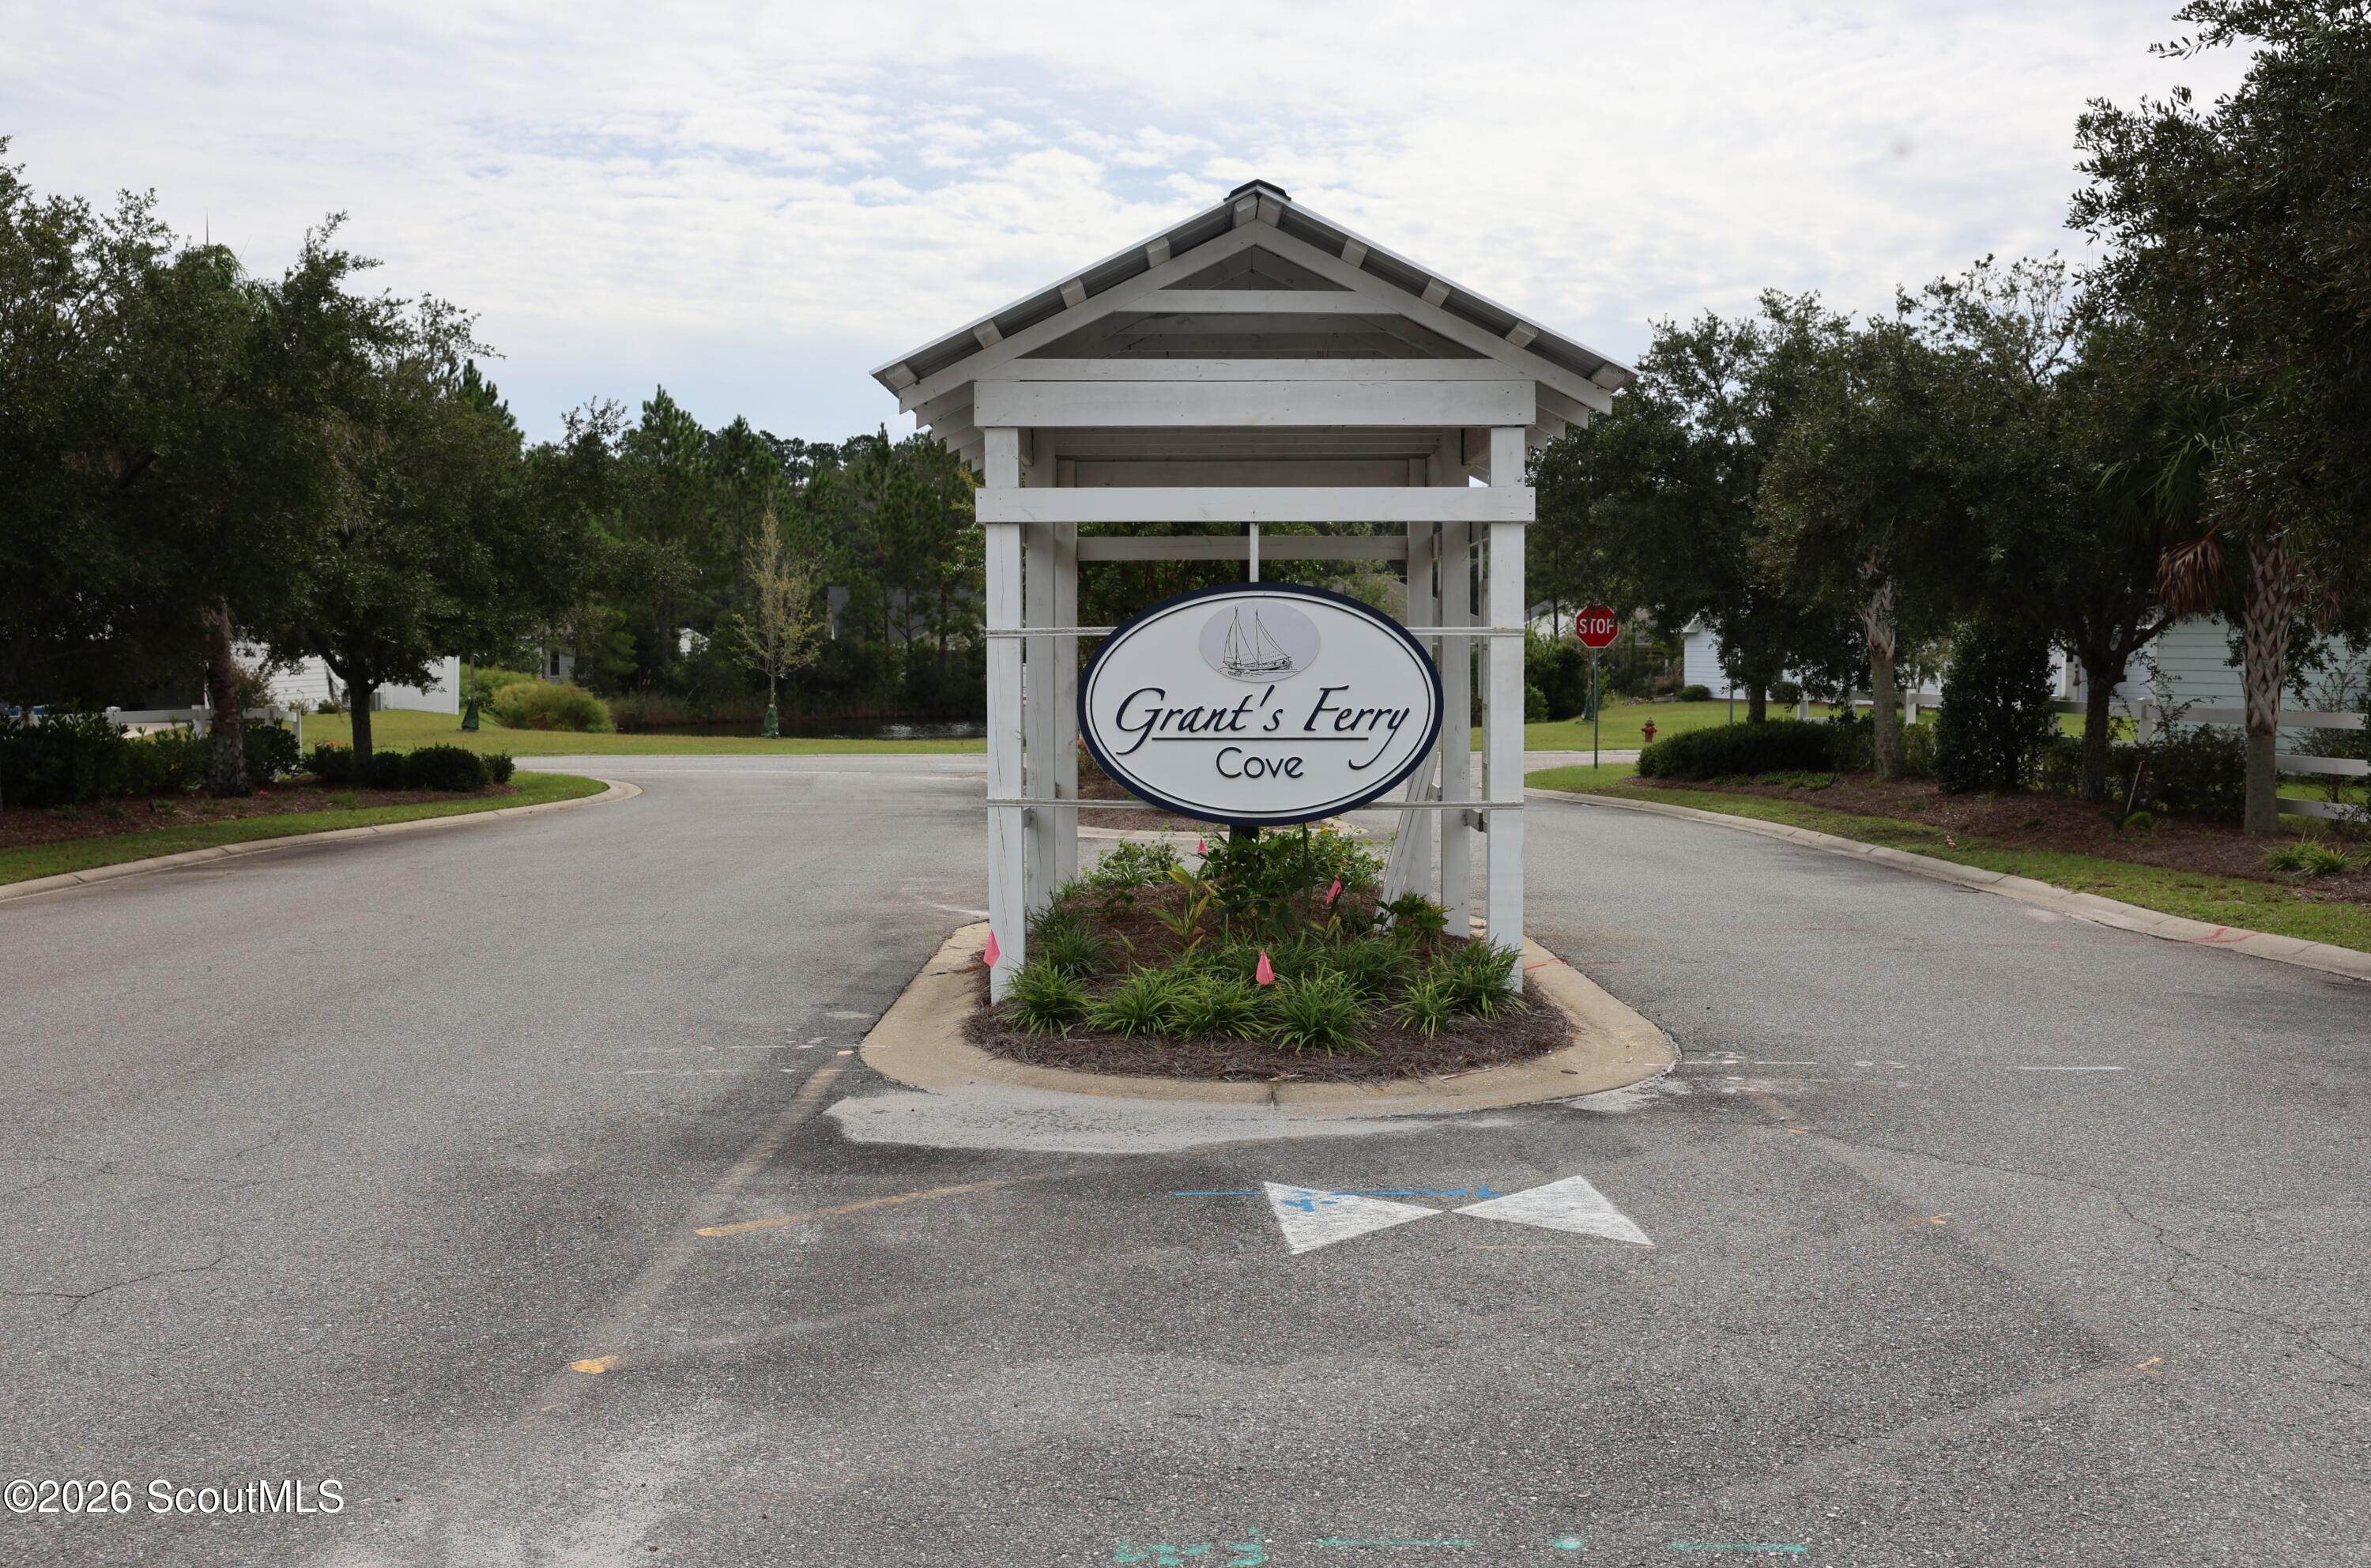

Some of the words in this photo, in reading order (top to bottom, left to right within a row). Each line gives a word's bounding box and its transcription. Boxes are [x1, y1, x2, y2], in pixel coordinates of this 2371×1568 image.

[1115, 684, 1284, 756] Grant's
[1303, 684, 1410, 770] Ferry
[1216, 746, 1304, 779] Cove
